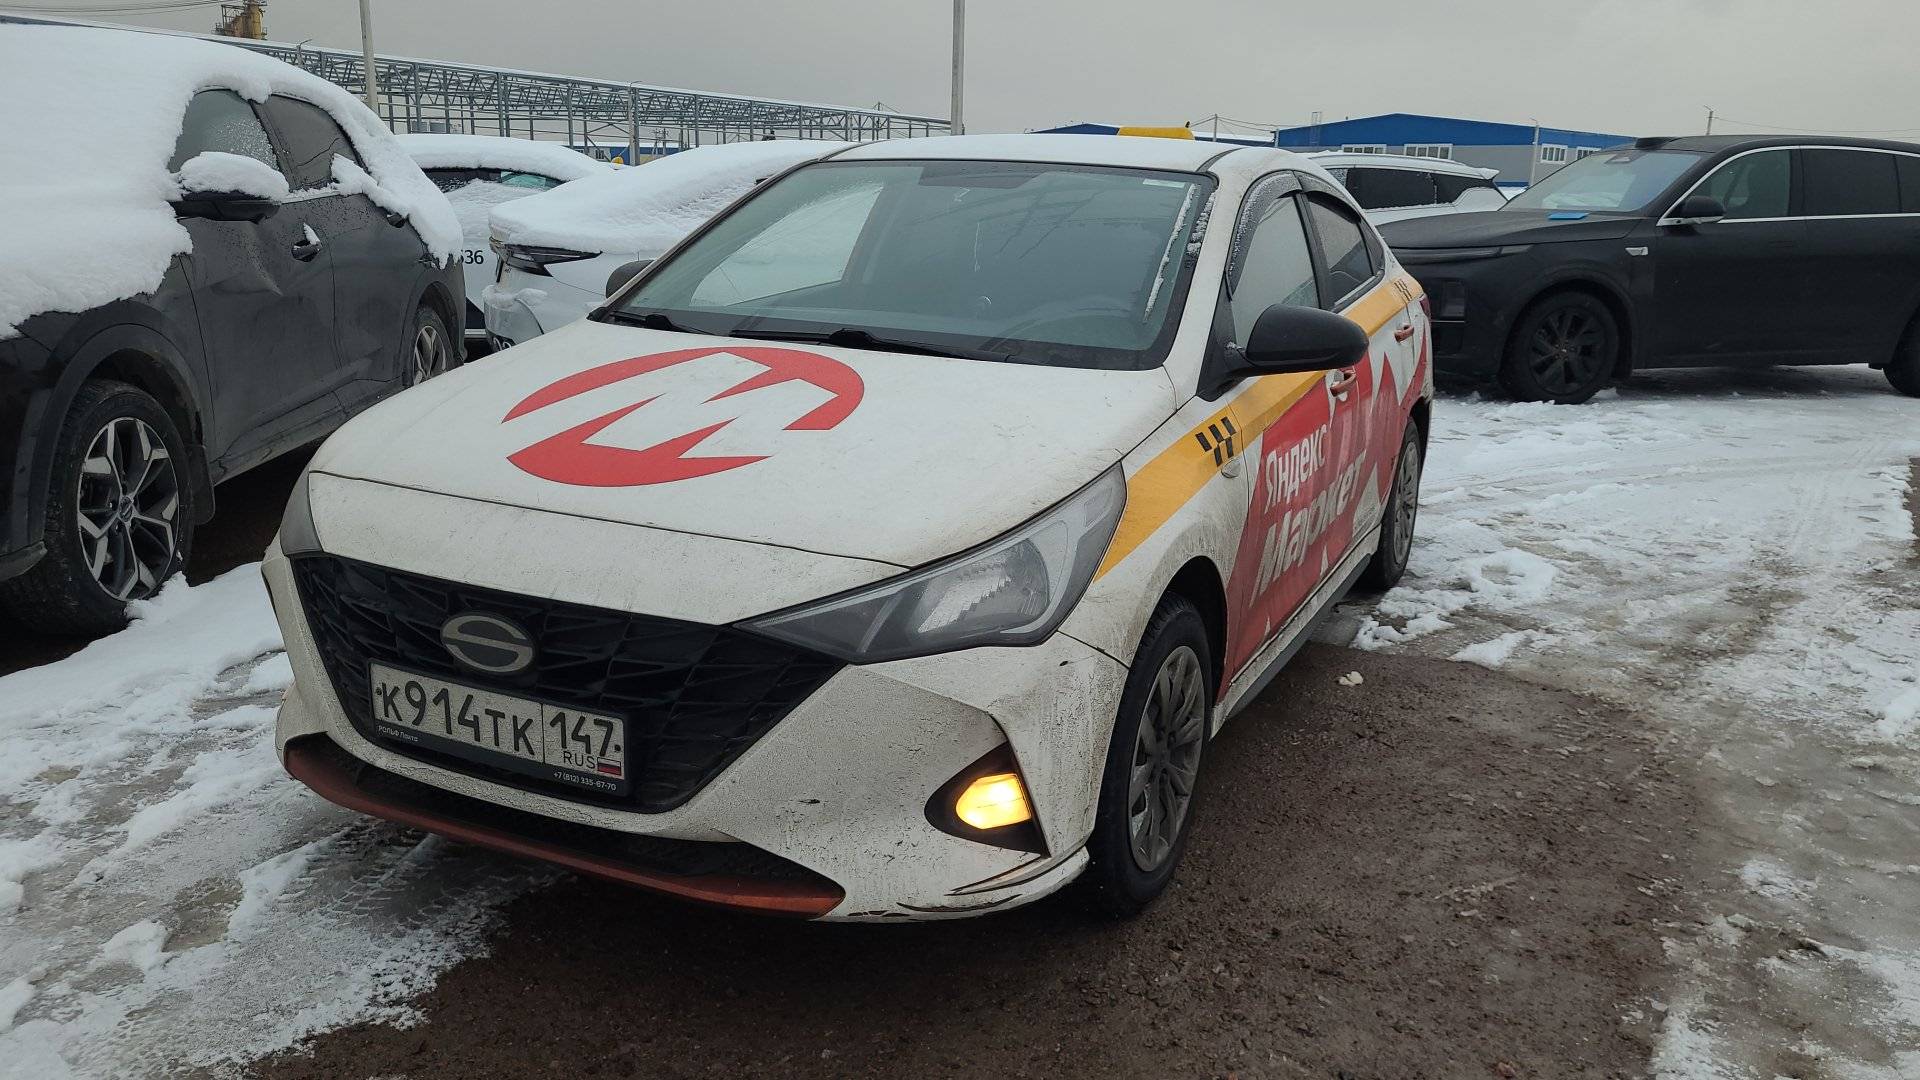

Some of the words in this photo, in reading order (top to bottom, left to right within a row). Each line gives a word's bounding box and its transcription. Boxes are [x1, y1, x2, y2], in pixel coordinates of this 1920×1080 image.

[1264, 424, 1328, 515] Яндекс
[1248, 449, 1367, 608] Маркет
[381, 681, 536, 756] К914ТК
[549, 711, 614, 757] 147
[553, 771, 562, 779] +7
[563, 772, 579, 783] (812)
[563, 750, 596, 769] RUS
